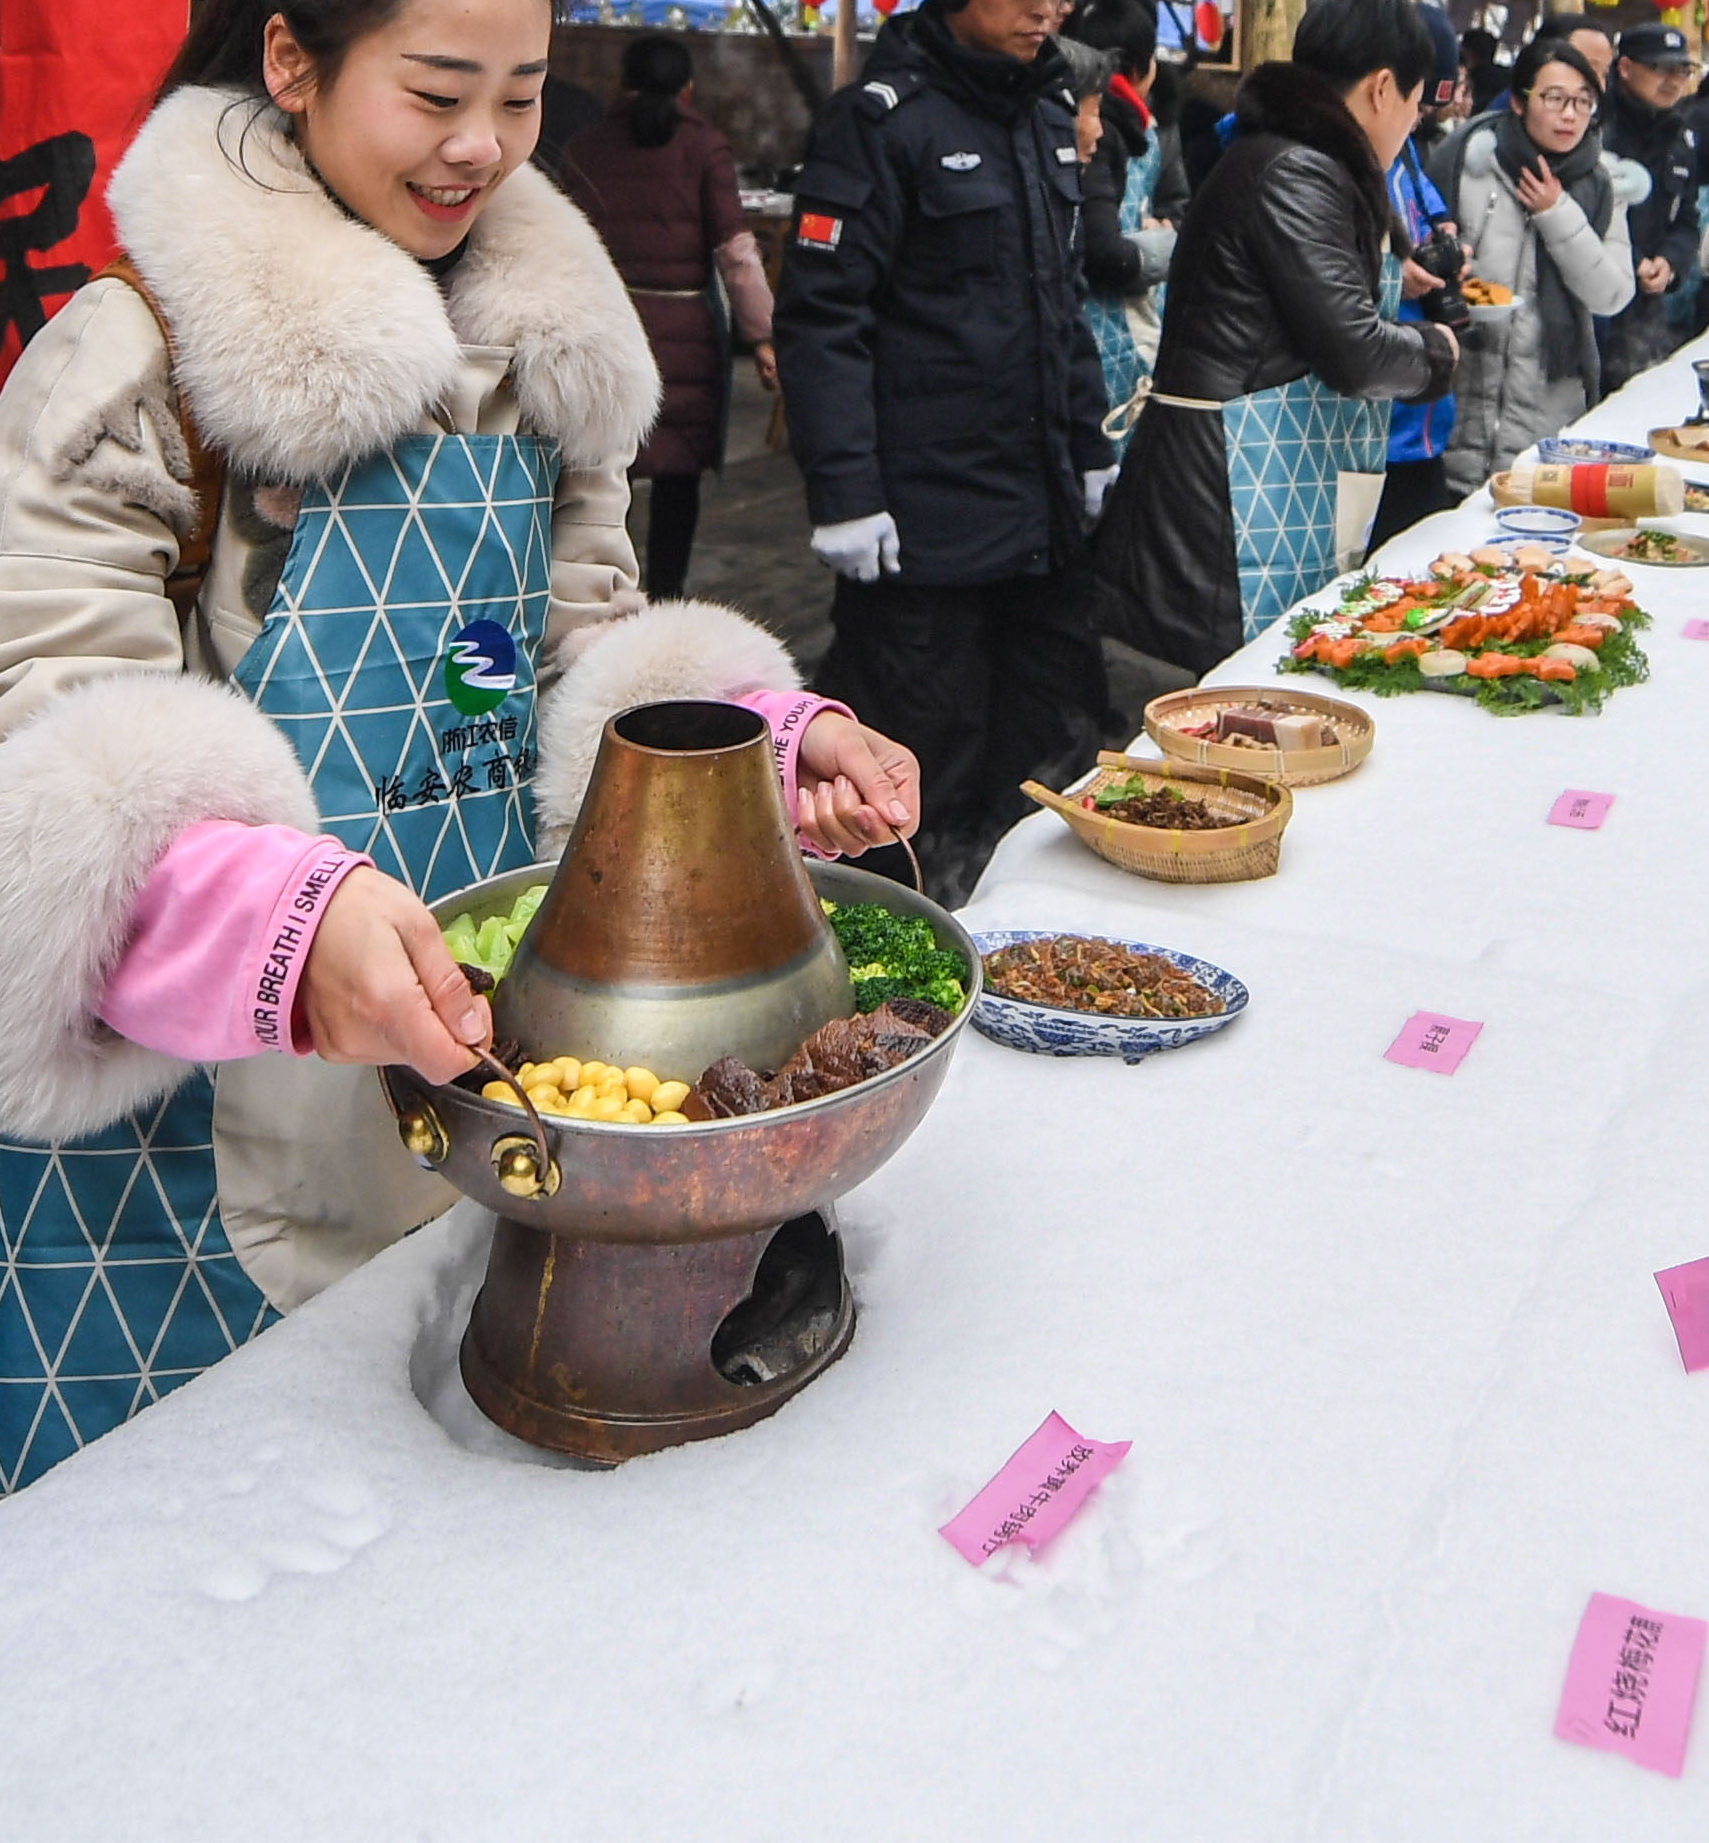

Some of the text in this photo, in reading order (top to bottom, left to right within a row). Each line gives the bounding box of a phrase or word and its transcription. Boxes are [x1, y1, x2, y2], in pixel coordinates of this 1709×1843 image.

[442, 716, 518, 754] 浙江农信
[294, 860, 345, 913] SMELL
[288, 915, 307, 925] I
[257, 924, 302, 1005] BREATH
